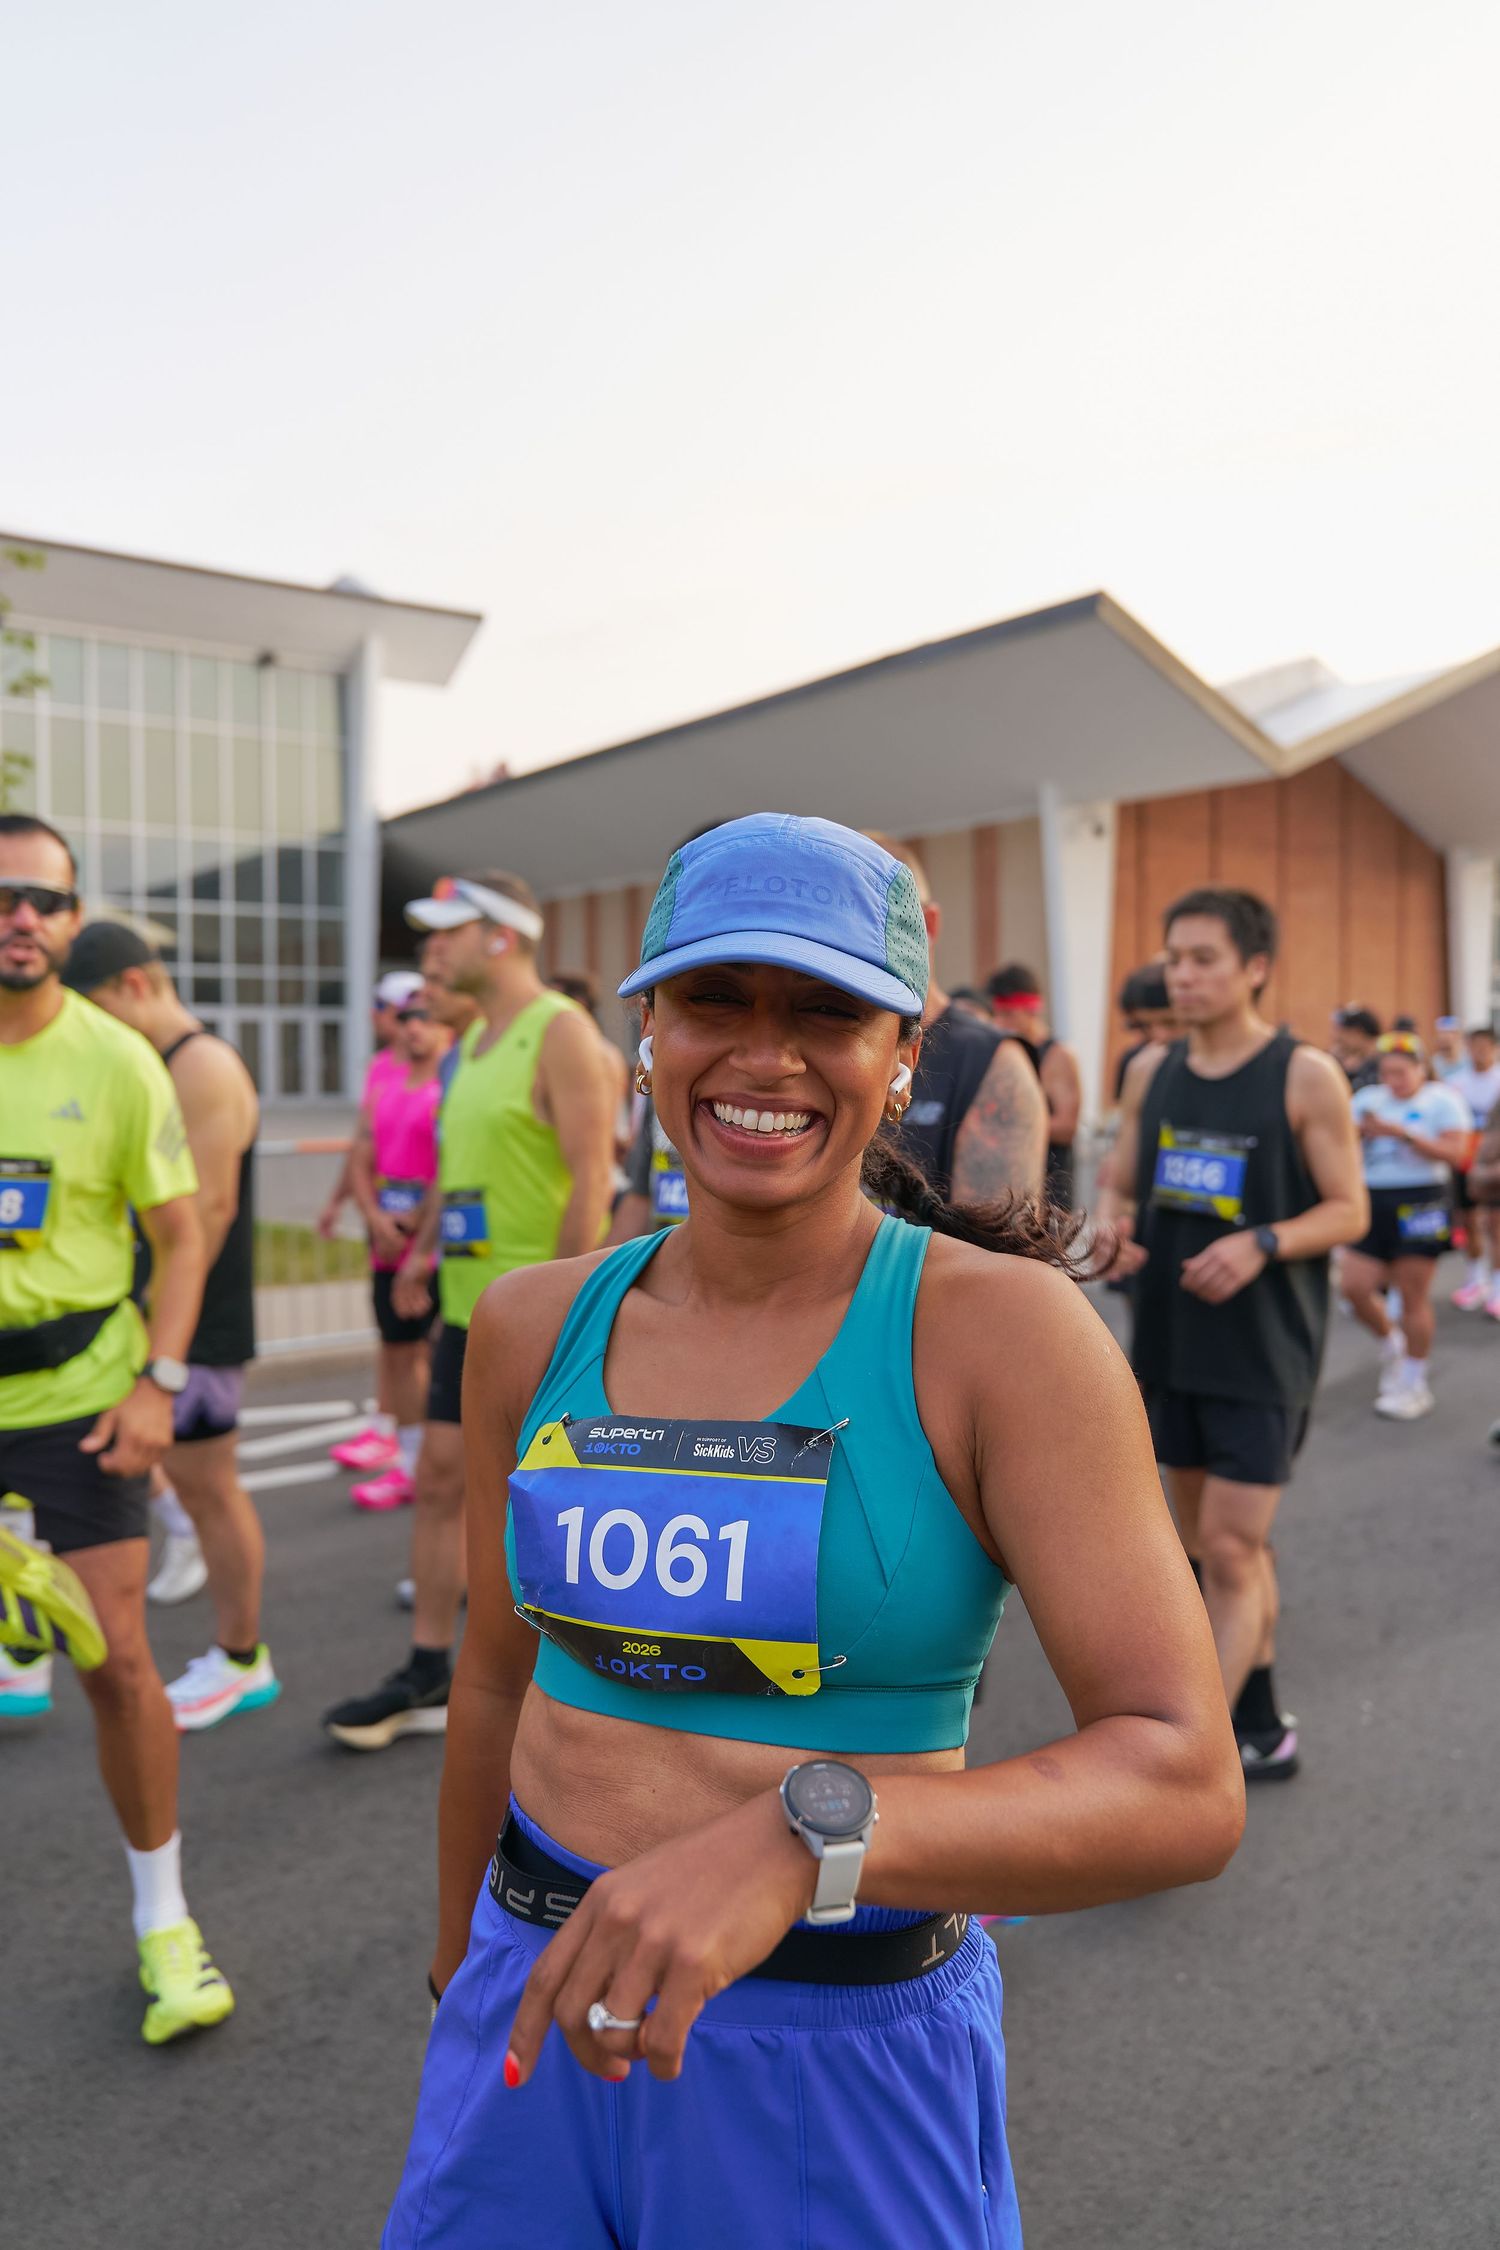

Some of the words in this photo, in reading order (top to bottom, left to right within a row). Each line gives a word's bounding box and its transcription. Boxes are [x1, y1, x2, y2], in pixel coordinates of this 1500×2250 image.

[708, 875, 856, 910] PELOTON
[693, 1443, 735, 1458] SickKids
[738, 1436, 777, 1464] VS
[557, 1506, 749, 1602] 1061
[622, 1641, 661, 1656] 2026
[595, 1654, 707, 1680] 10KTO
